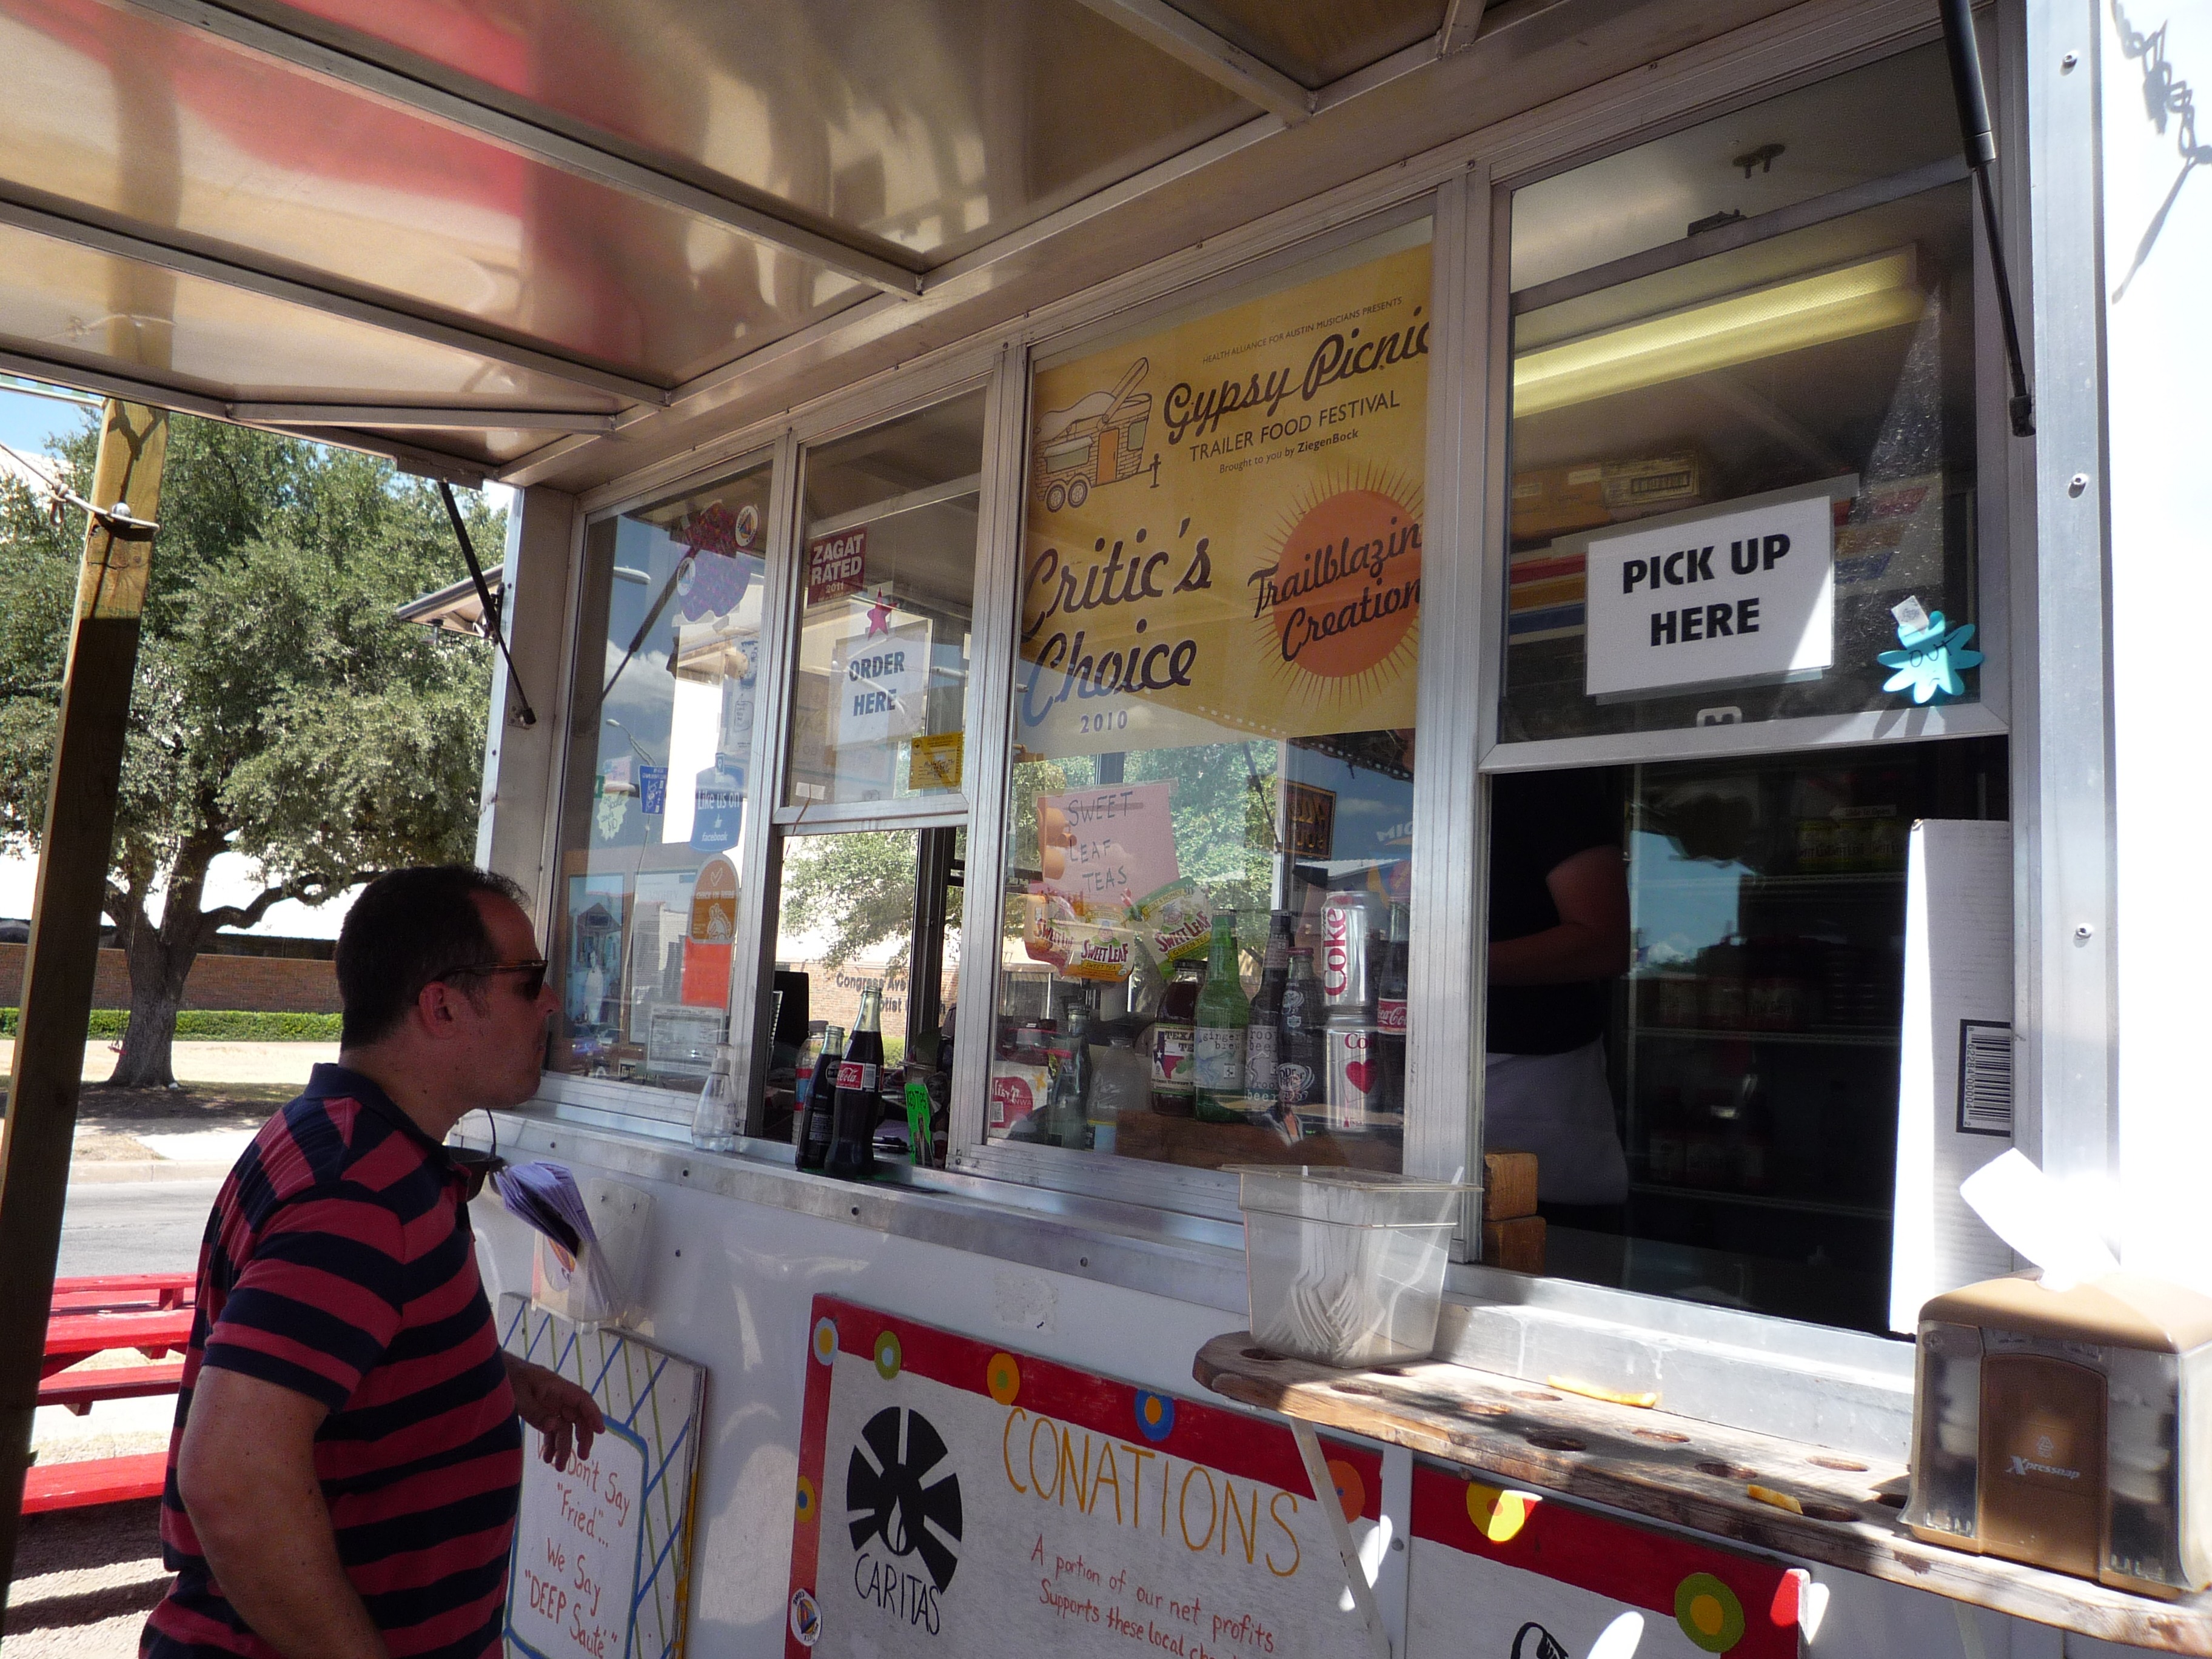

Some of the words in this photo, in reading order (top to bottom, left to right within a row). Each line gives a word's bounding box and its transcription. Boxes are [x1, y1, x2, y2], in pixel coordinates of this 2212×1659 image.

[1202, 348, 1230, 364] HEALTH
[1231, 338, 1267, 355] ALLIANCE
[1269, 333, 1284, 344] FOR
[1285, 323, 1315, 339] AUSTIN
[1316, 309, 1361, 329] MUSICIANS
[1362, 296, 1403, 315] PRESENTS
[1163, 366, 1298, 444] Gypsy
[1302, 306, 1430, 401] Picnic
[1189, 431, 1254, 463] TRAILER
[1260, 415, 1312, 444] FOOD
[1319, 389, 1400, 427] FESTIVAL
[1219, 457, 1252, 474] Brought
[1255, 455, 1264, 464] to
[1266, 451, 1282, 464] you
[1285, 446, 1295, 458] by
[1298, 428, 1359, 454] ZiegenBock
[813, 534, 864, 565] ZAGAT
[1623, 546, 1715, 594] PICK
[1731, 533, 1791, 575] UP
[811, 556, 862, 586] RATED
[1021, 517, 1212, 642] Critic's
[1247, 517, 1422, 618] Trailblazin
[825, 581, 844, 594] 2011
[1650, 597, 1760, 647] HERE
[849, 651, 905, 682] ORDER
[1023, 618, 1198, 728] Choice
[853, 689, 897, 717] HERE
[1079, 710, 1128, 734] 2010
[698, 790, 714, 810] Like
[717, 793, 726, 809] us
[729, 792, 740, 808] on
[1068, 791, 1133, 826] SWEET
[702, 831, 728, 842] facebook
[1069, 839, 1111, 862] LEAF
[1082, 865, 1127, 893] TEAS
[1155, 928, 1190, 953] SWEET
[1184, 911, 1211, 937] LEAF
[1173, 942, 1196, 956] GREEN
[1196, 934, 1208, 944] TEA
[1081, 939, 1108, 962] SWEET
[1108, 943, 1128, 963] LEAF
[1323, 908, 1347, 996] Coke
[836, 971, 885, 992] Congress
[1165, 1031, 1195, 1041] TEXA
[1178, 1043, 1195, 1053] TE
[1202, 1031, 1241, 1042] ginger
[1215, 1041, 1241, 1050] brew
[1250, 1030, 1276, 1040] roo
[1966, 1044, 1976, 1074] 62284
[1965, 1078, 1974, 1108] 00004
[568, 1447, 600, 1493] Don't
[605, 1472, 631, 1528] Say
[1002, 1406, 1299, 1577] CONATIONS
[548, 1537, 566, 1573] We
[574, 1554, 601, 1617] Say
[525, 1569, 567, 1624] "DEEP
[854, 1553, 940, 1635] CARITAS
[1031, 1533, 1044, 1566] A
[1055, 1555, 1101, 1586] portion
[1109, 1569, 1127, 1594] of
[1137, 1586, 1163, 1608] our
[1170, 1598, 1201, 1625] net
[1213, 1614, 1273, 1653] profits
[1039, 1578, 1100, 1623] Supports
[1106, 1607, 1144, 1641] these
[1149, 1621, 1184, 1657] local
